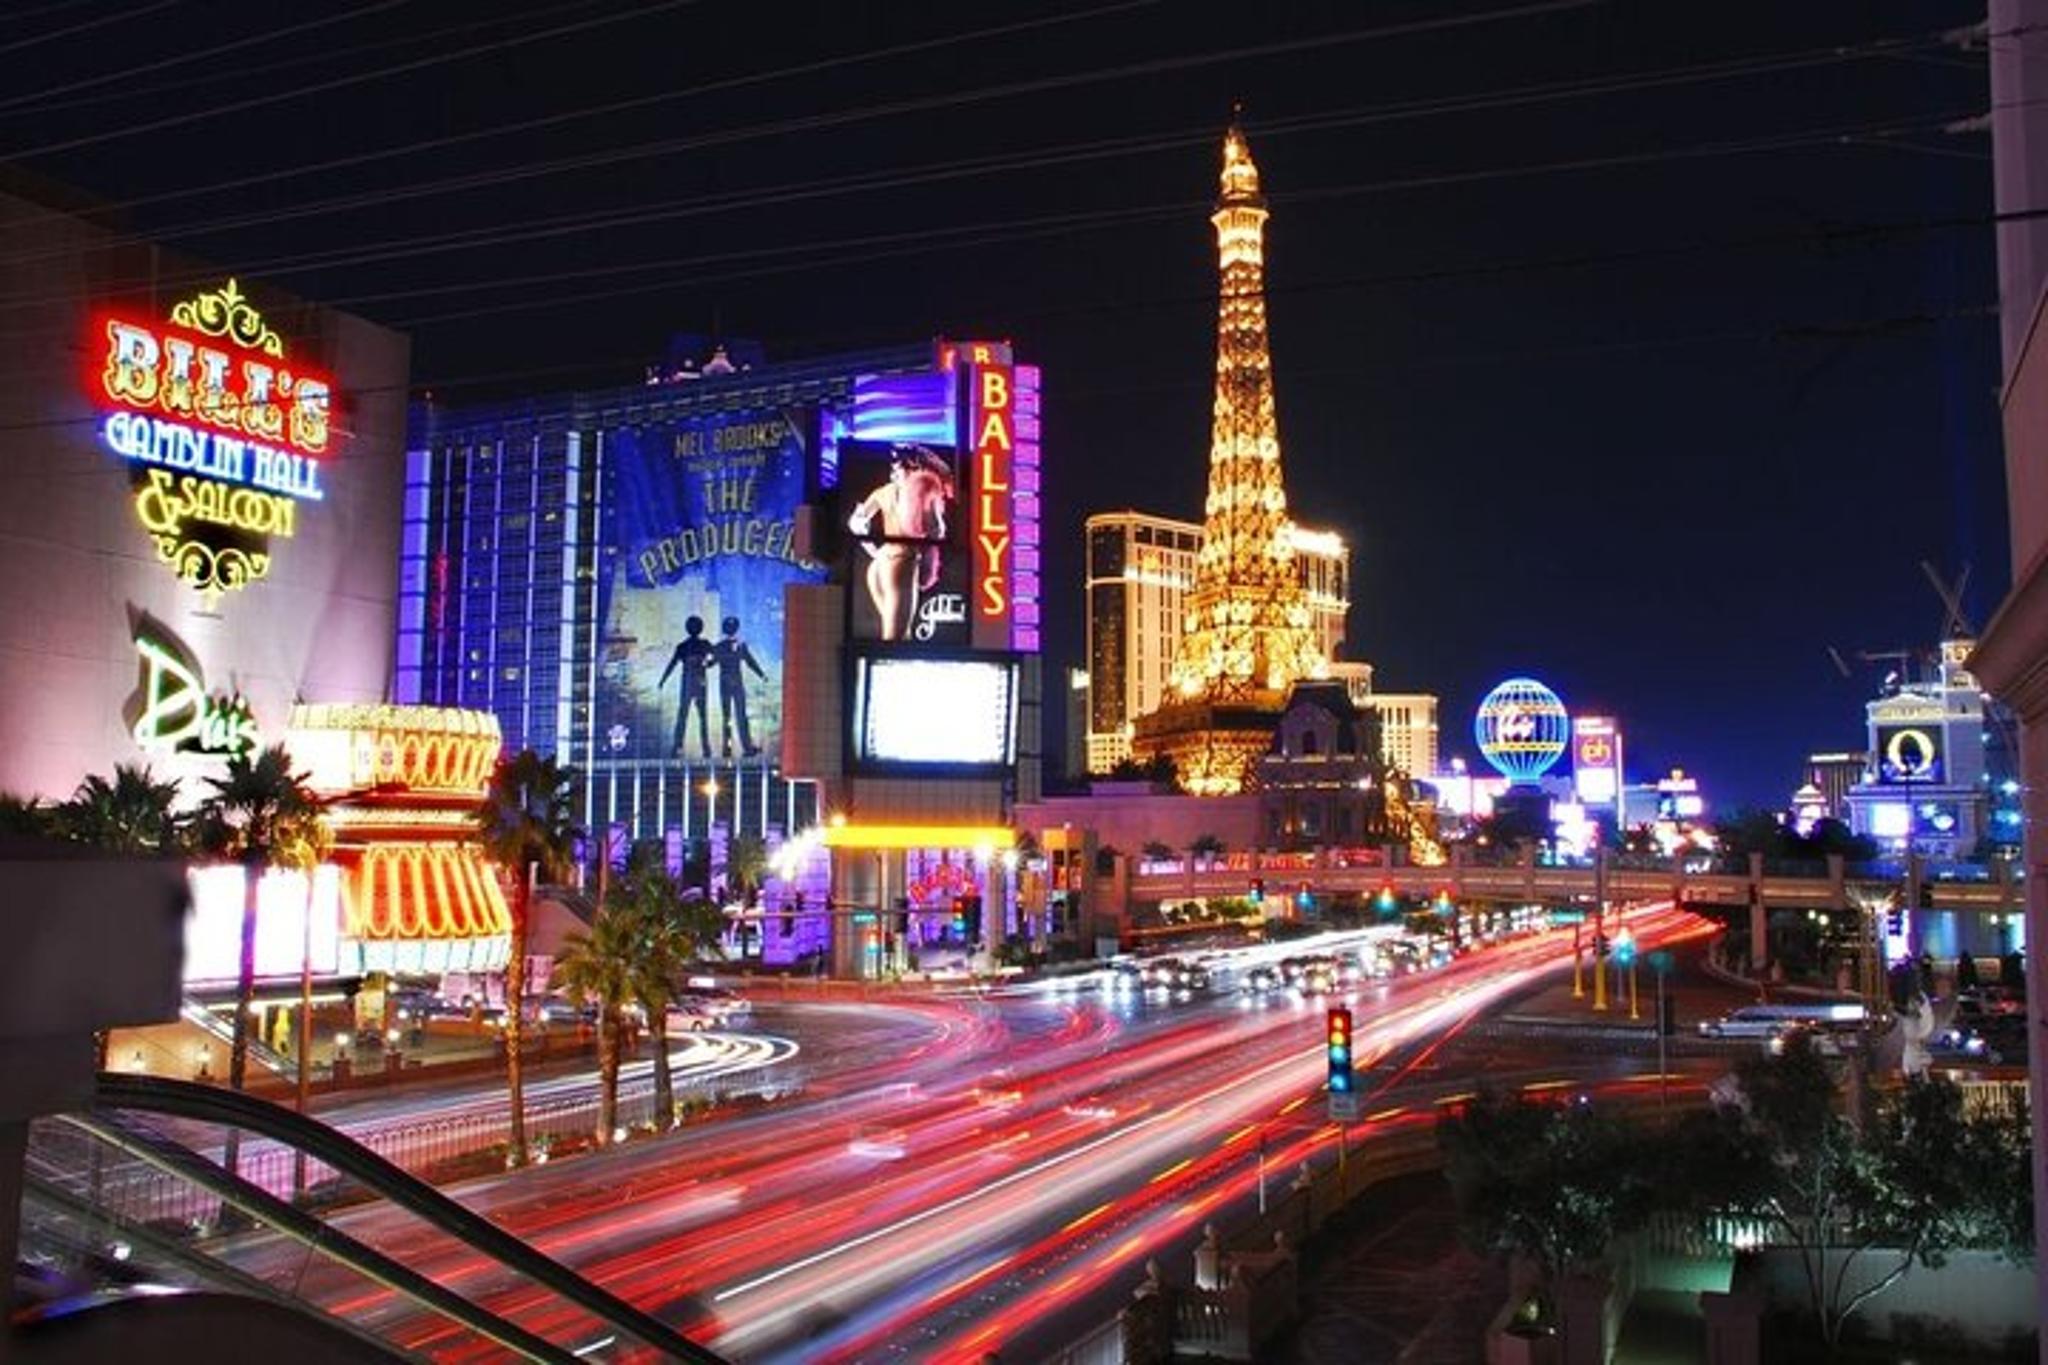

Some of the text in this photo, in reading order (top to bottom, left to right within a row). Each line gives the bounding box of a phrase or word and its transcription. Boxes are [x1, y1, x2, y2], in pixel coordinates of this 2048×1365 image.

[103, 319, 329, 452] BILL'S
[253, 447, 324, 500] HALL
[674, 431, 705, 458] MEL
[136, 468, 295, 537] & SALOON
[703, 477, 757, 513] THE
[639, 516, 823, 584] PRODUCE
